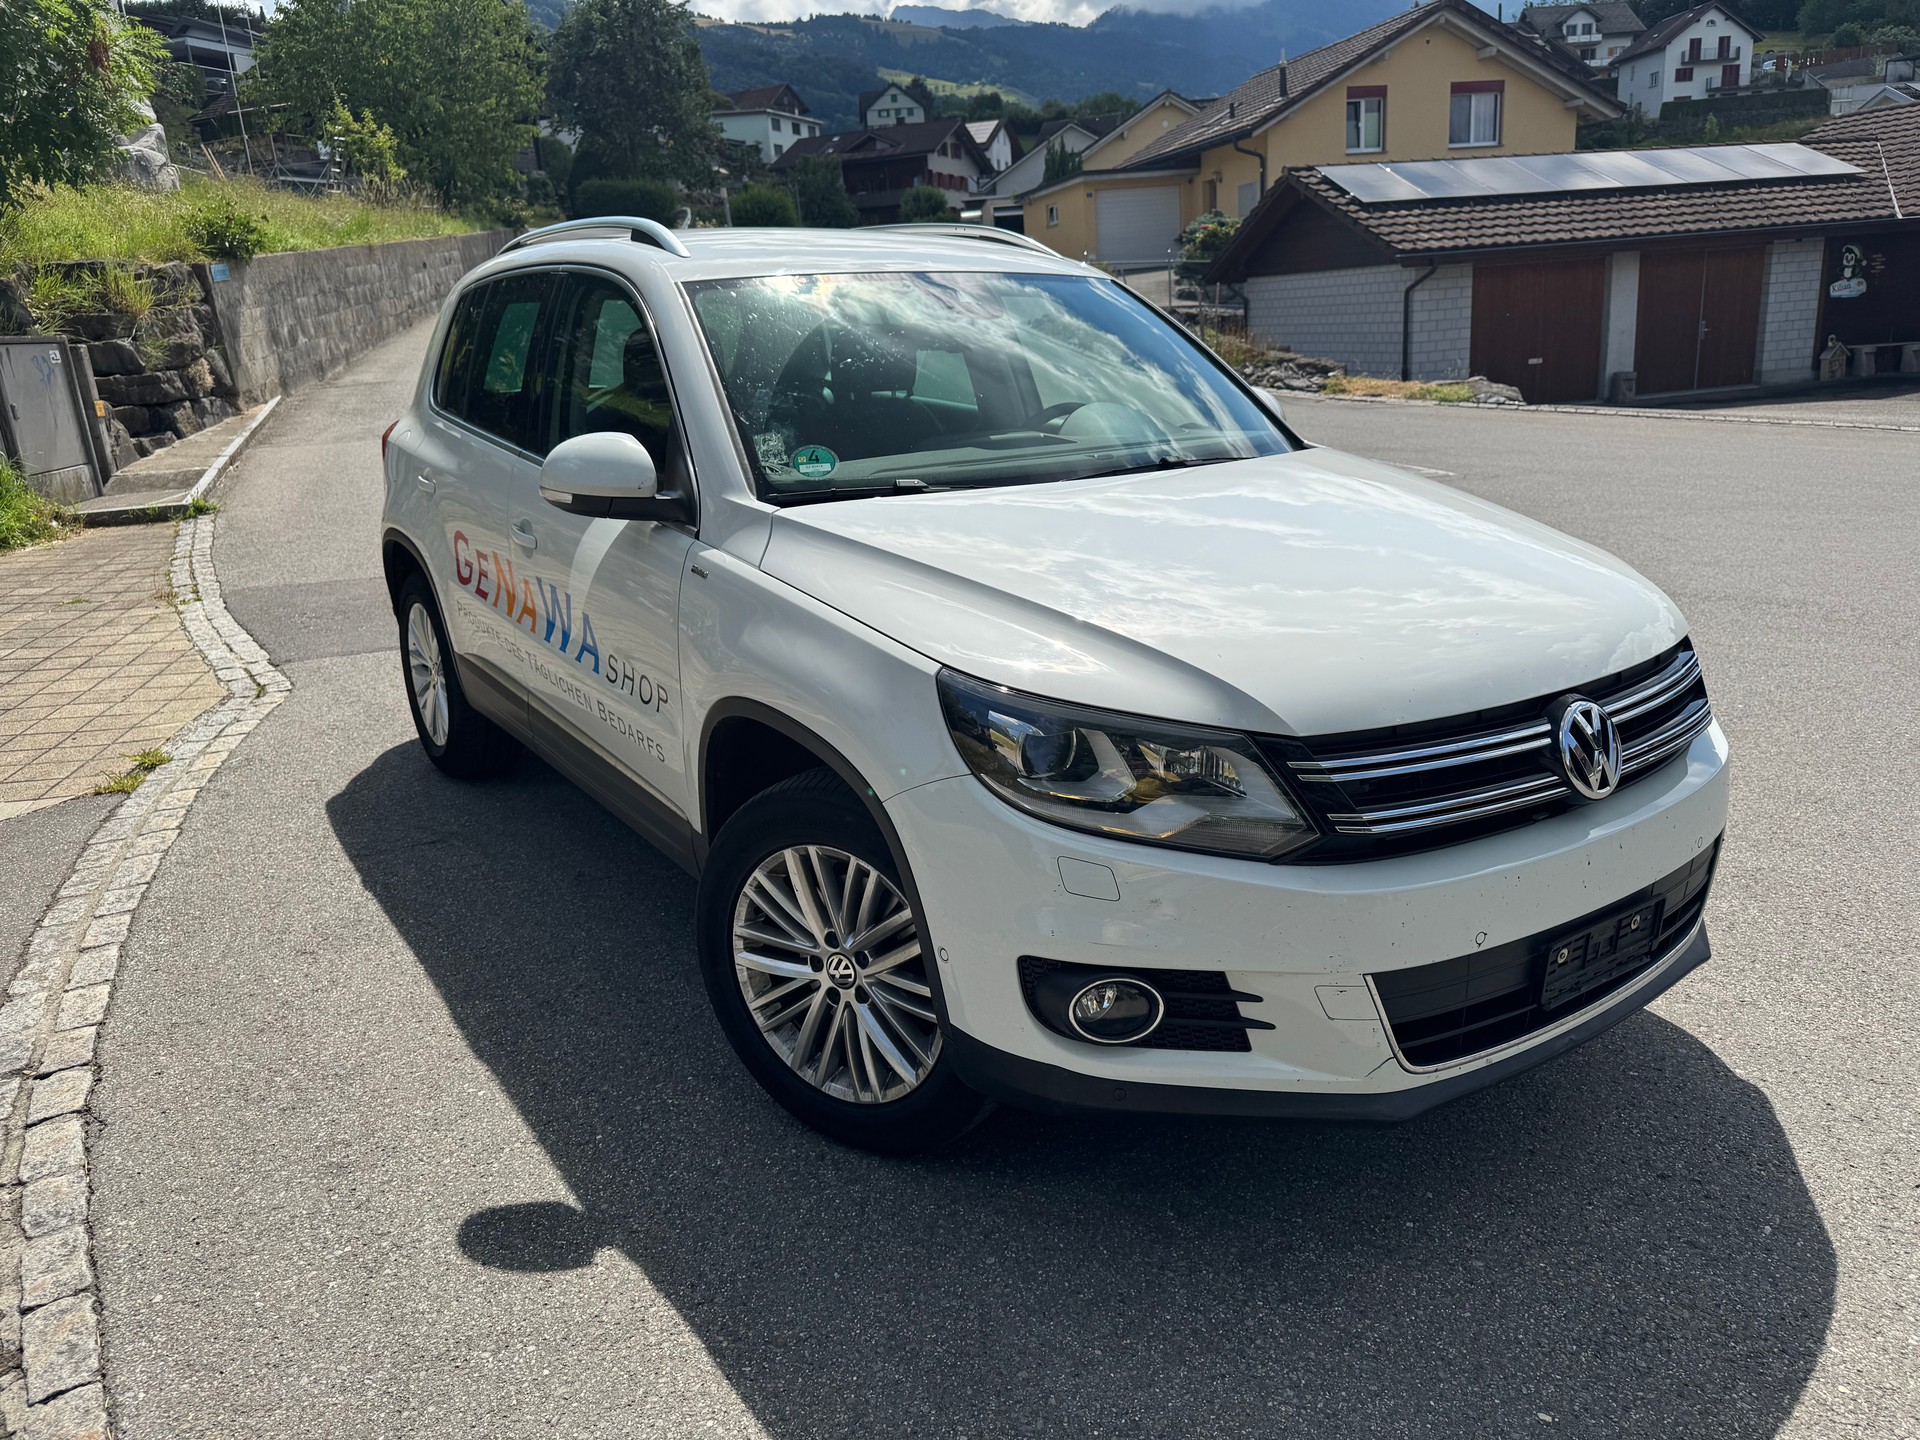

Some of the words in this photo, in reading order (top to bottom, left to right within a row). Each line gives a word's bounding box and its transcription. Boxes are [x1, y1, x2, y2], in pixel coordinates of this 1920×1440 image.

[808, 450, 820, 463] 4
[454, 530, 600, 675] GENAWA
[605, 653, 669, 713] SHOP
[525, 650, 593, 712] TÄGLICHEN
[597, 700, 665, 763] BEDARFS
